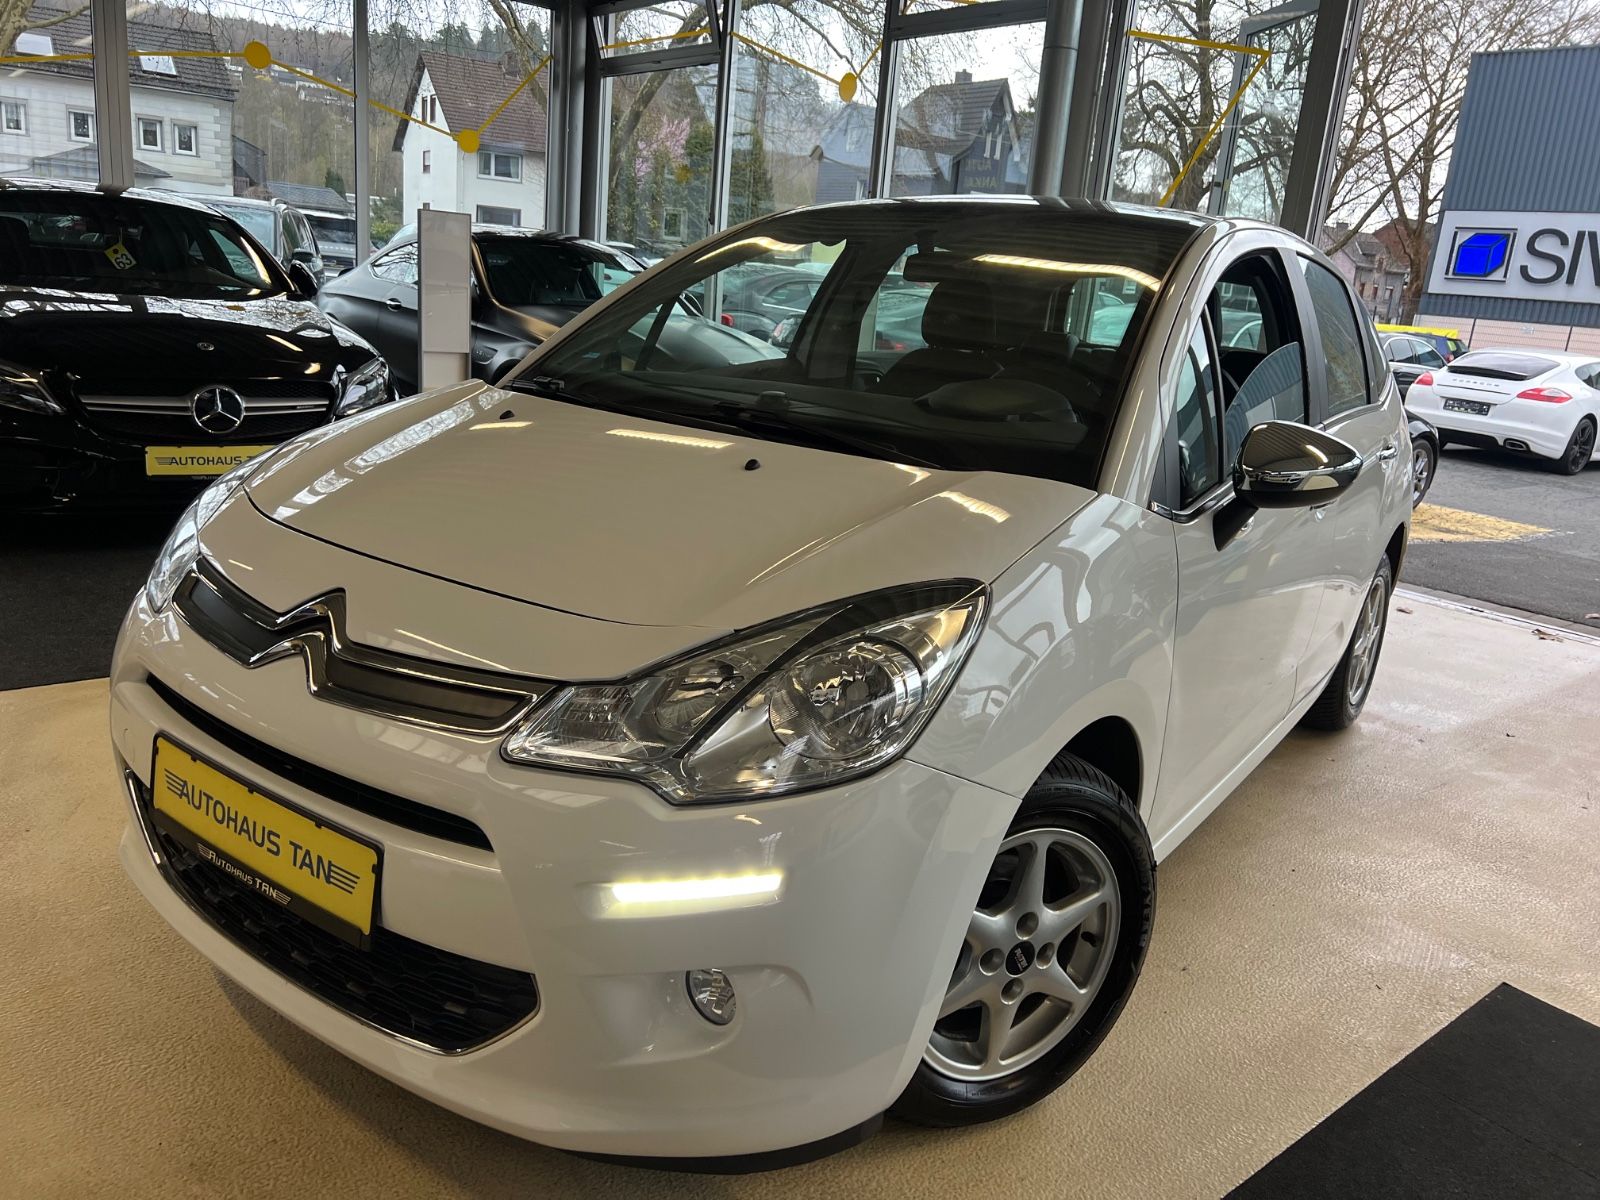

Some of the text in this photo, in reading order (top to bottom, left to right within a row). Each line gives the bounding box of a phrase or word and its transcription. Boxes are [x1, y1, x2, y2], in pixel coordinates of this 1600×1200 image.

[115, 253, 132, 268] 63
[169, 456, 243, 466] AUTOHAUS
[178, 779, 333, 885] AUTOHAUS TAN
[254, 877, 277, 898] TAN
